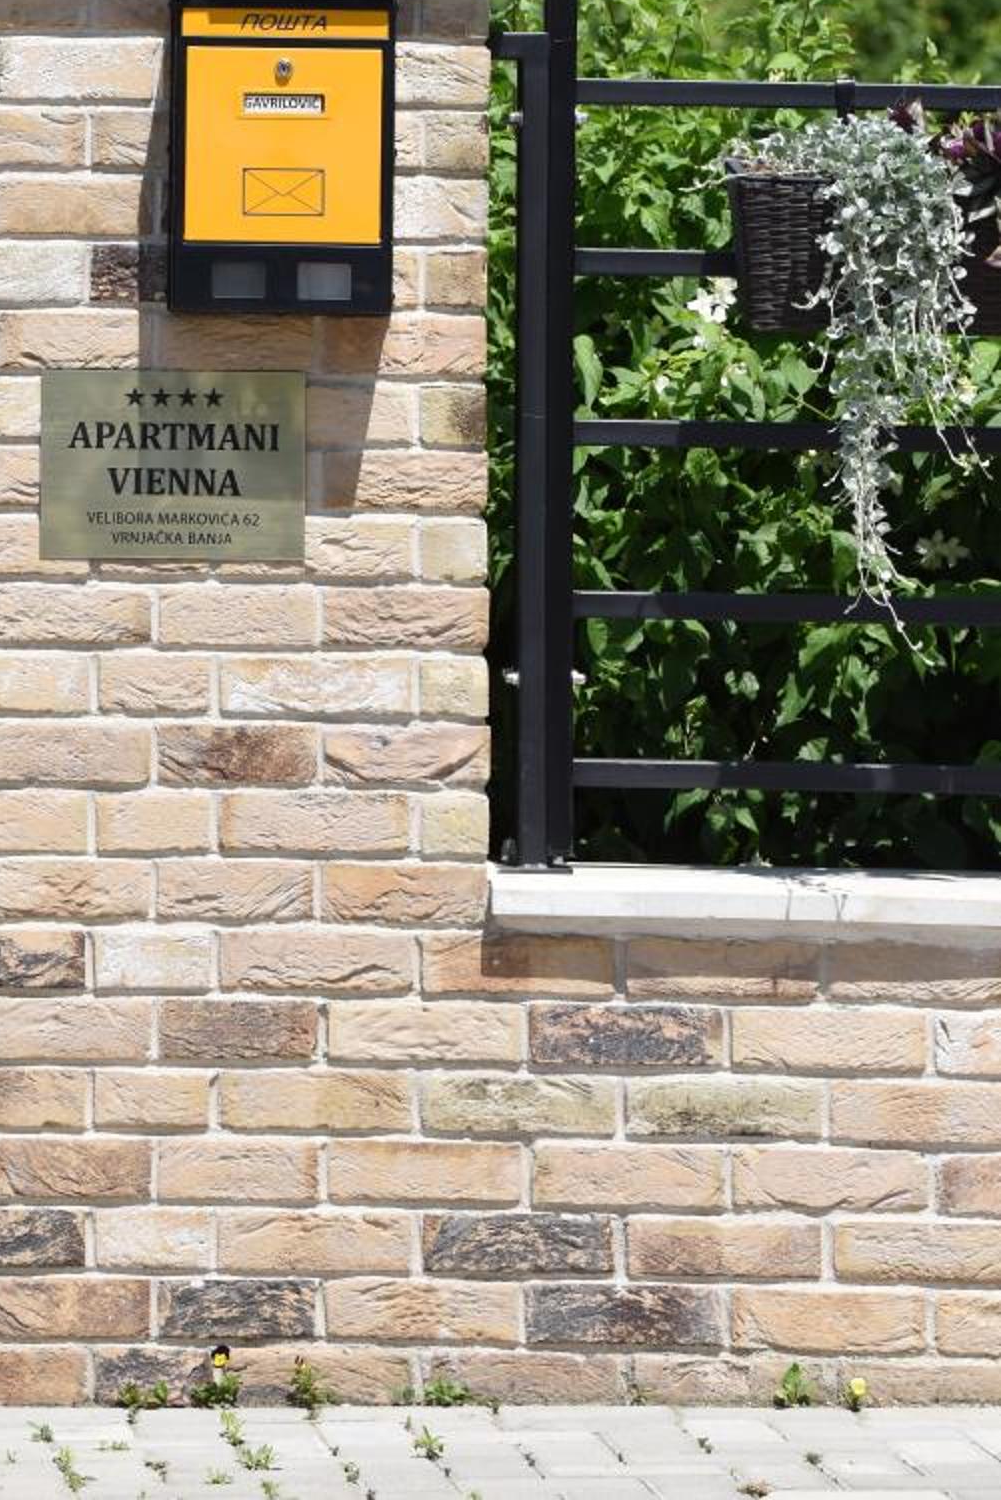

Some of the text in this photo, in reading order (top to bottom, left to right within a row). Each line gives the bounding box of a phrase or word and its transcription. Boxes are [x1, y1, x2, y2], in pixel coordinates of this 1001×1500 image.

[240, 13, 327, 31] ПОШТА
[68, 421, 280, 451] APARTMANI
[107, 468, 241, 496] VIENNA
[87, 511, 153, 525] VELIBORA
[243, 513, 260, 527] 62
[112, 530, 232, 545] VRNJAČKA BANJA
